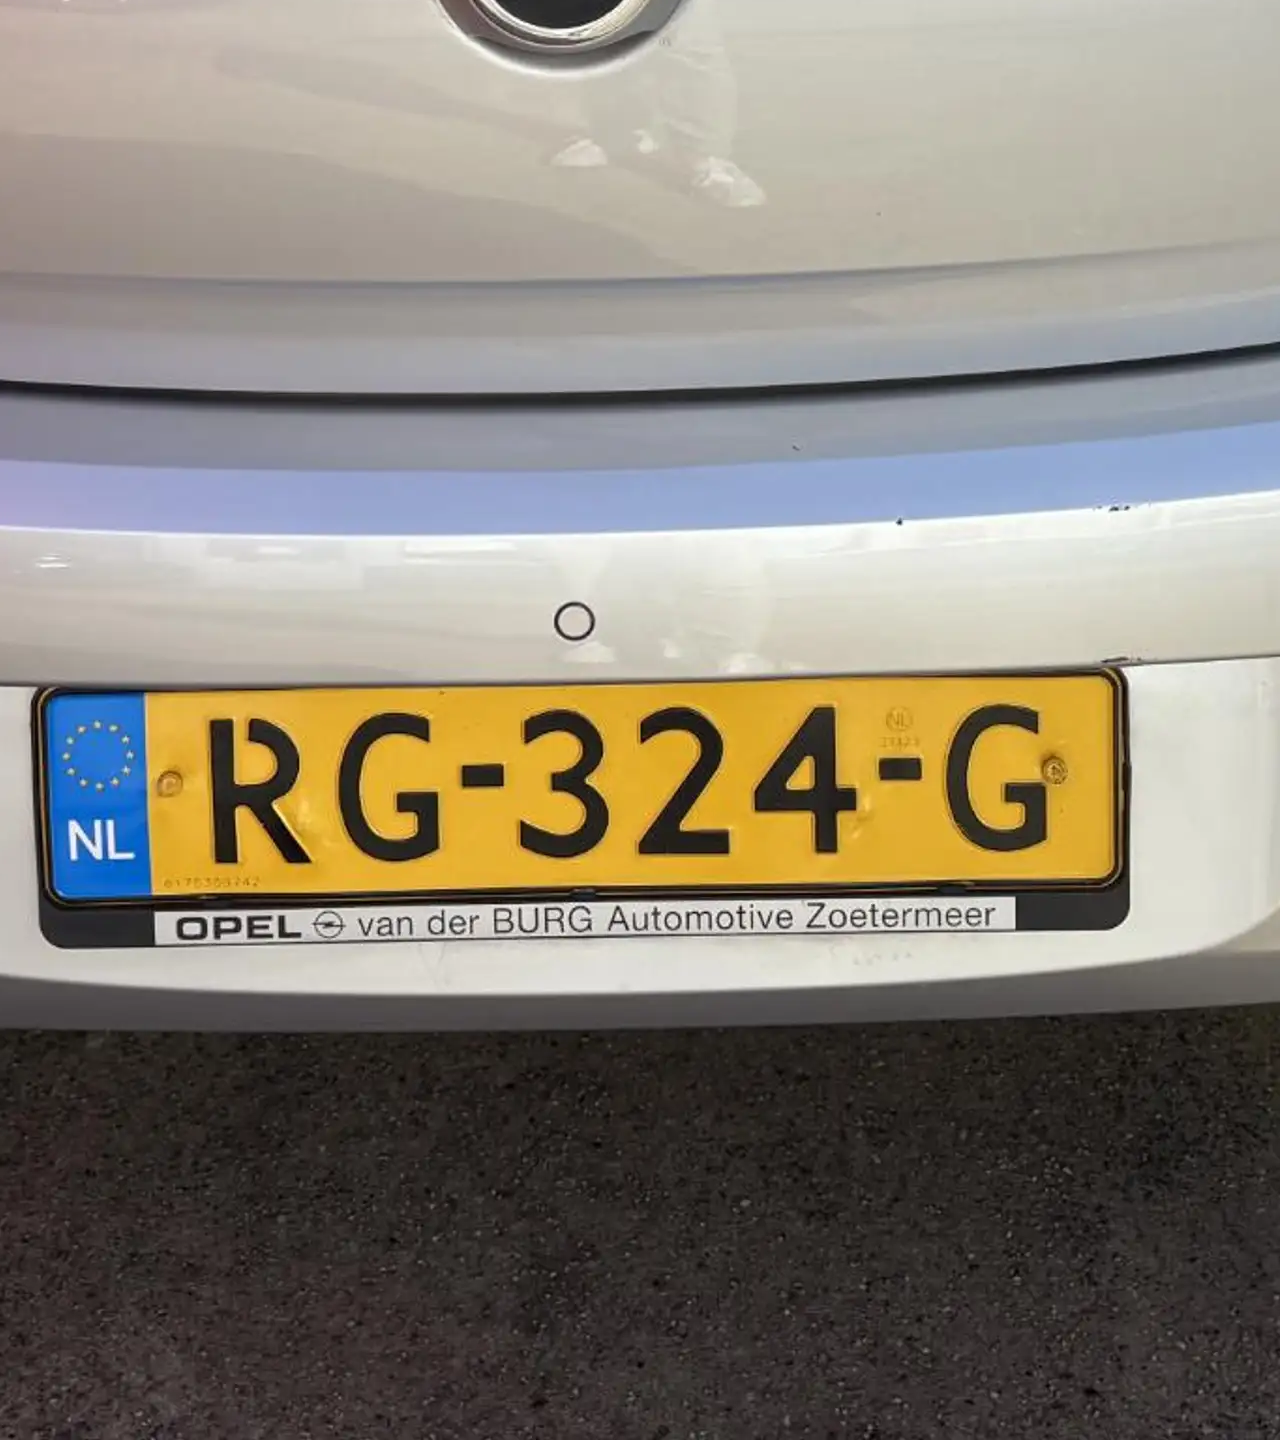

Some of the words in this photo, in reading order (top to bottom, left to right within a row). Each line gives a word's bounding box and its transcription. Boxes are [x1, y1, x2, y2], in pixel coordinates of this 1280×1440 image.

[209, 705, 1047, 864] RG-324-G
[67, 819, 135, 860] NL
[175, 914, 303, 941] OPEL
[357, 916, 414, 938] van
[427, 909, 480, 936] der
[493, 905, 593, 934] BURG
[607, 904, 794, 933] Automotive
[805, 902, 996, 930] Zoetermeer
